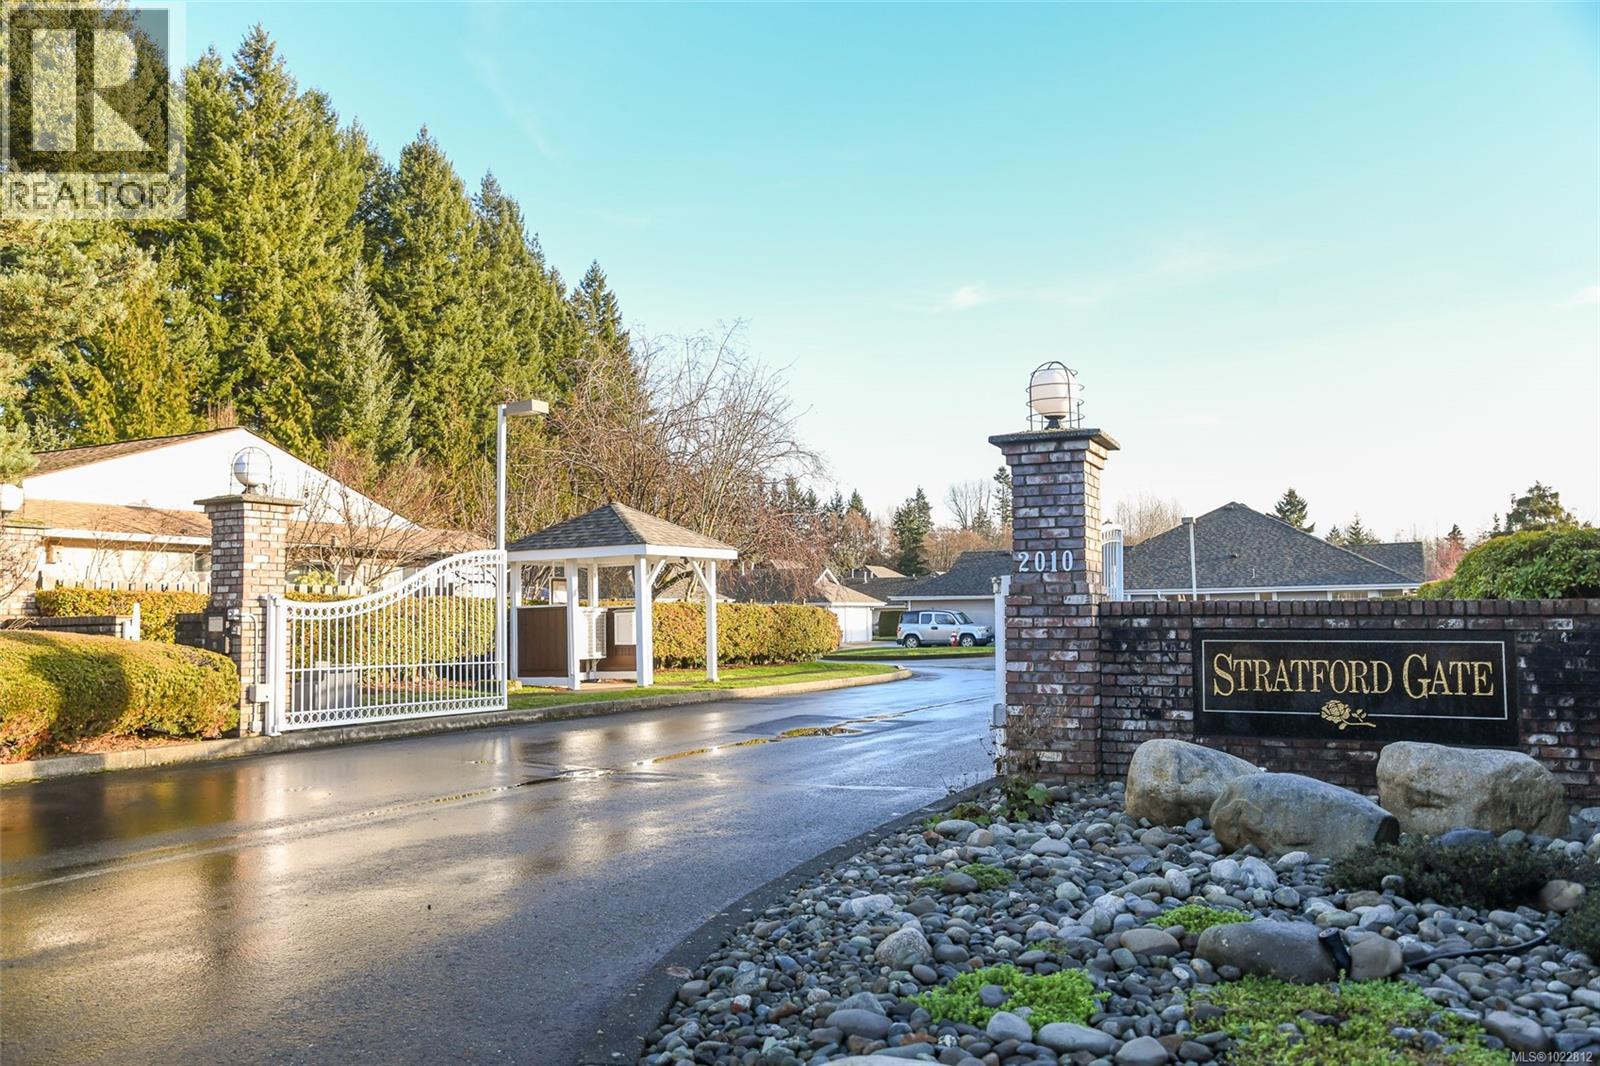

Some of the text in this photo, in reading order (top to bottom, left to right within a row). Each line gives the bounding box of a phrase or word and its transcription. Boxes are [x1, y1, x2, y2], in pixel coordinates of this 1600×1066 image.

[1018, 550, 1073, 572] 2010
[1212, 653, 1494, 699] STRATFORD GATE
